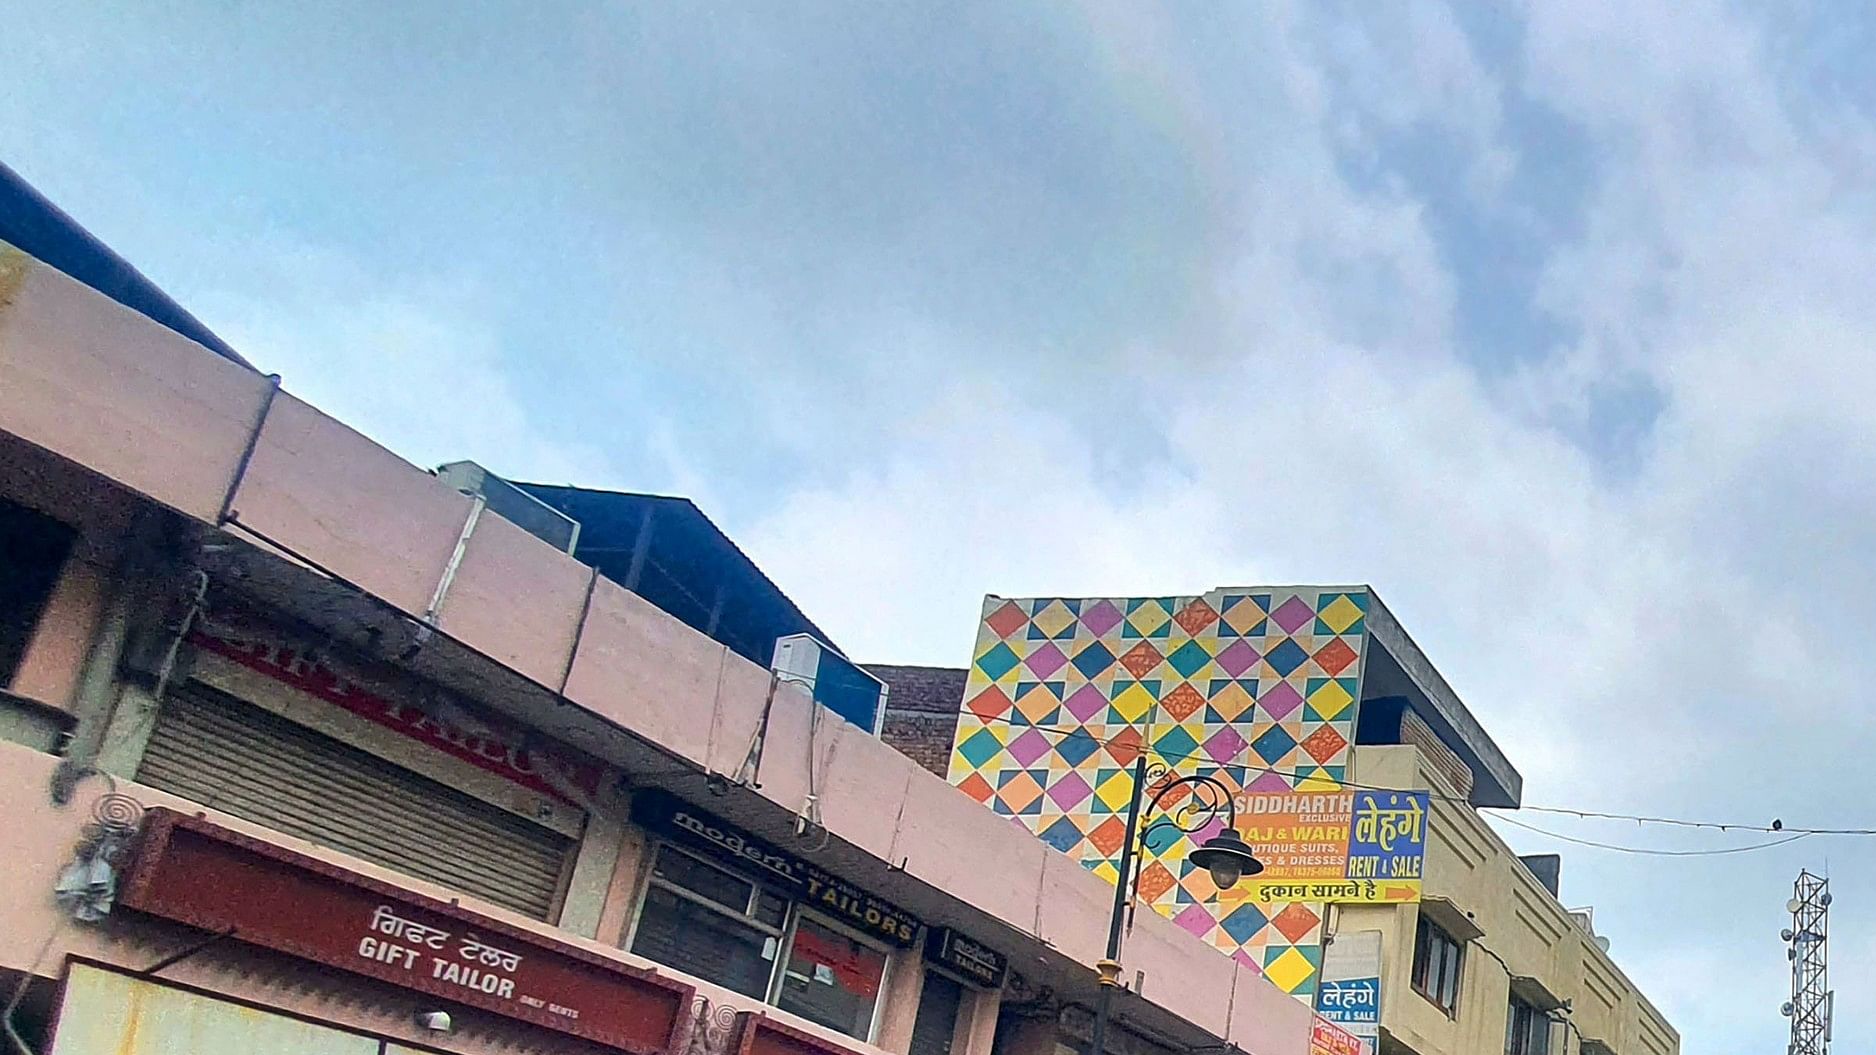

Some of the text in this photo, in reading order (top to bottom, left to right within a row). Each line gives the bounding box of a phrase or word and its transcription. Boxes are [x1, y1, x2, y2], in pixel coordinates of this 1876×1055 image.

[1234, 794, 1353, 814] SIDDHARTH
[1299, 813, 1352, 823] EXCLUSIVE
[1356, 795, 1424, 851] लेहंगे
[1276, 828, 1288, 840] &
[1291, 826, 1349, 841] WARI
[1290, 856, 1345, 866] DRESSES
[1349, 857, 1379, 877] RENT
[1391, 856, 1421, 878] SALE
[1260, 880, 1378, 902] दुकान सामने है
[807, 878, 913, 942] TAILORS
[359, 937, 421, 969] GIFT
[432, 958, 516, 998] TAILOR
[1322, 981, 1375, 1009] लेहंगे
[1353, 1010, 1376, 1021] SALE
